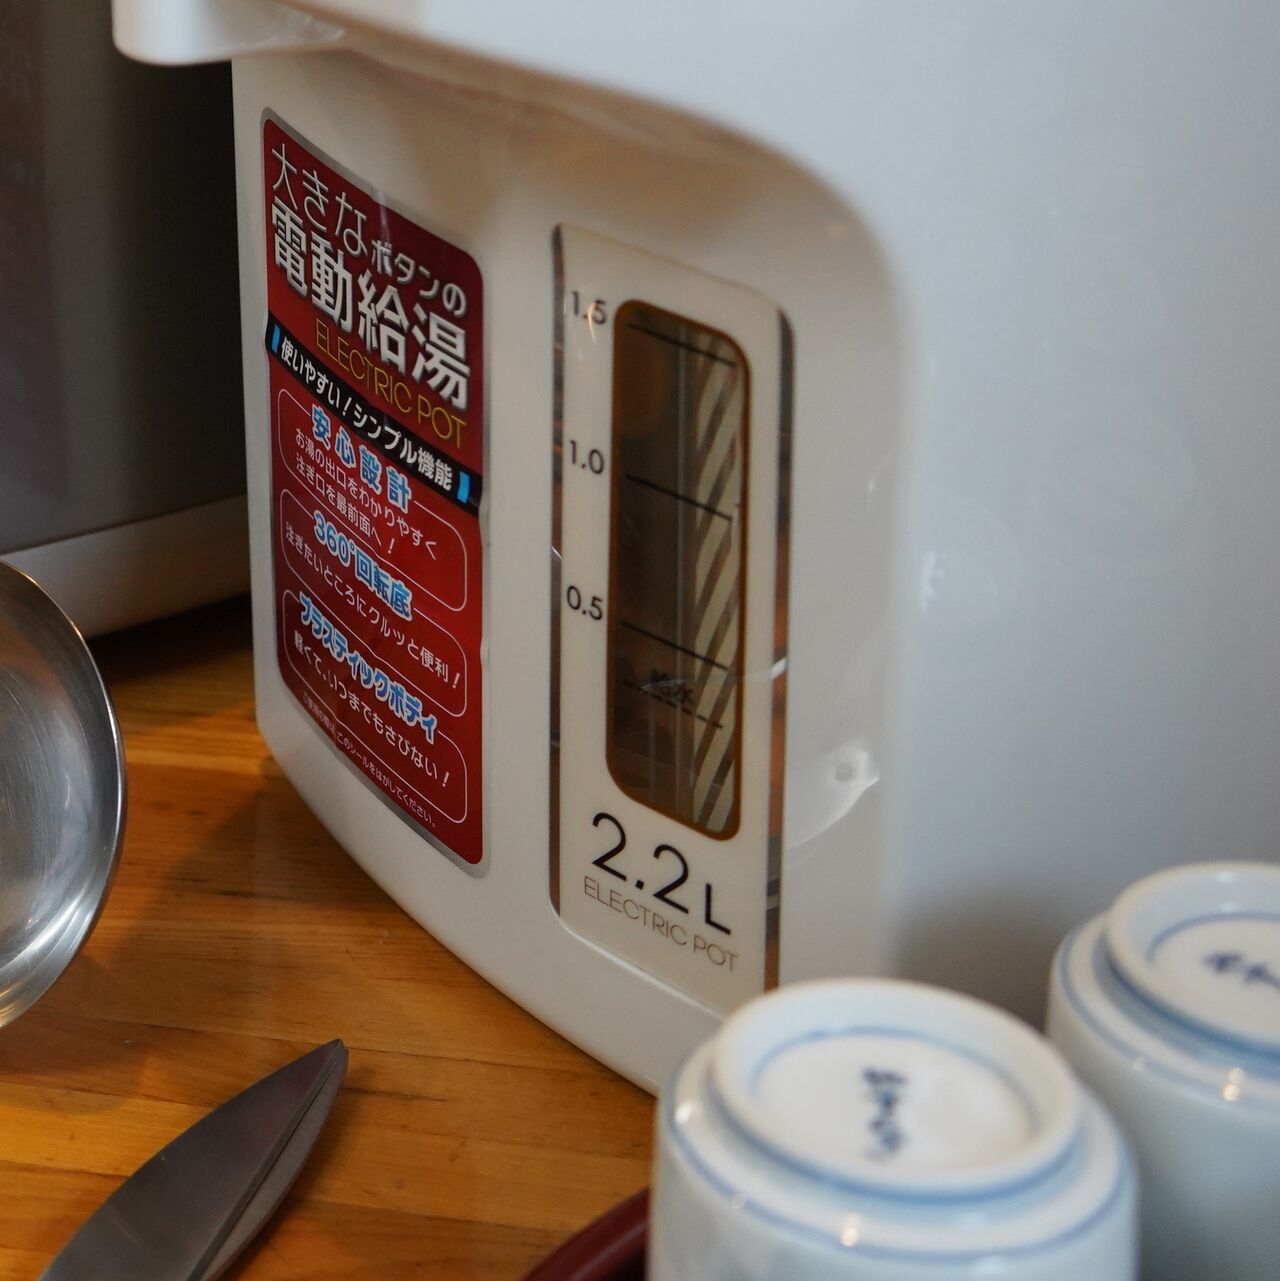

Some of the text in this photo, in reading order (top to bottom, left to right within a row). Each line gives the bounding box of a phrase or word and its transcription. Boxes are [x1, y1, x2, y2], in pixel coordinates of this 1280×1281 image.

[271, 142, 468, 318] 大きなボタンの
[271, 194, 472, 413] 電動給湯
[570, 290, 608, 325] 1.5
[281, 335, 454, 492] 使いやすい！シンプル機能
[315, 318, 468, 450] ELECTRIC POT
[294, 427, 439, 561] お湯の出口をわかりやすく
[311, 402, 413, 514] 安心設計
[568, 440, 605, 475] 1.0
[312, 509, 414, 622] 360°回転底
[566, 585, 604, 621] 0.5
[298, 591, 439, 745] プラスティックボディ
[583, 875, 738, 974] ELECTRIC POT
